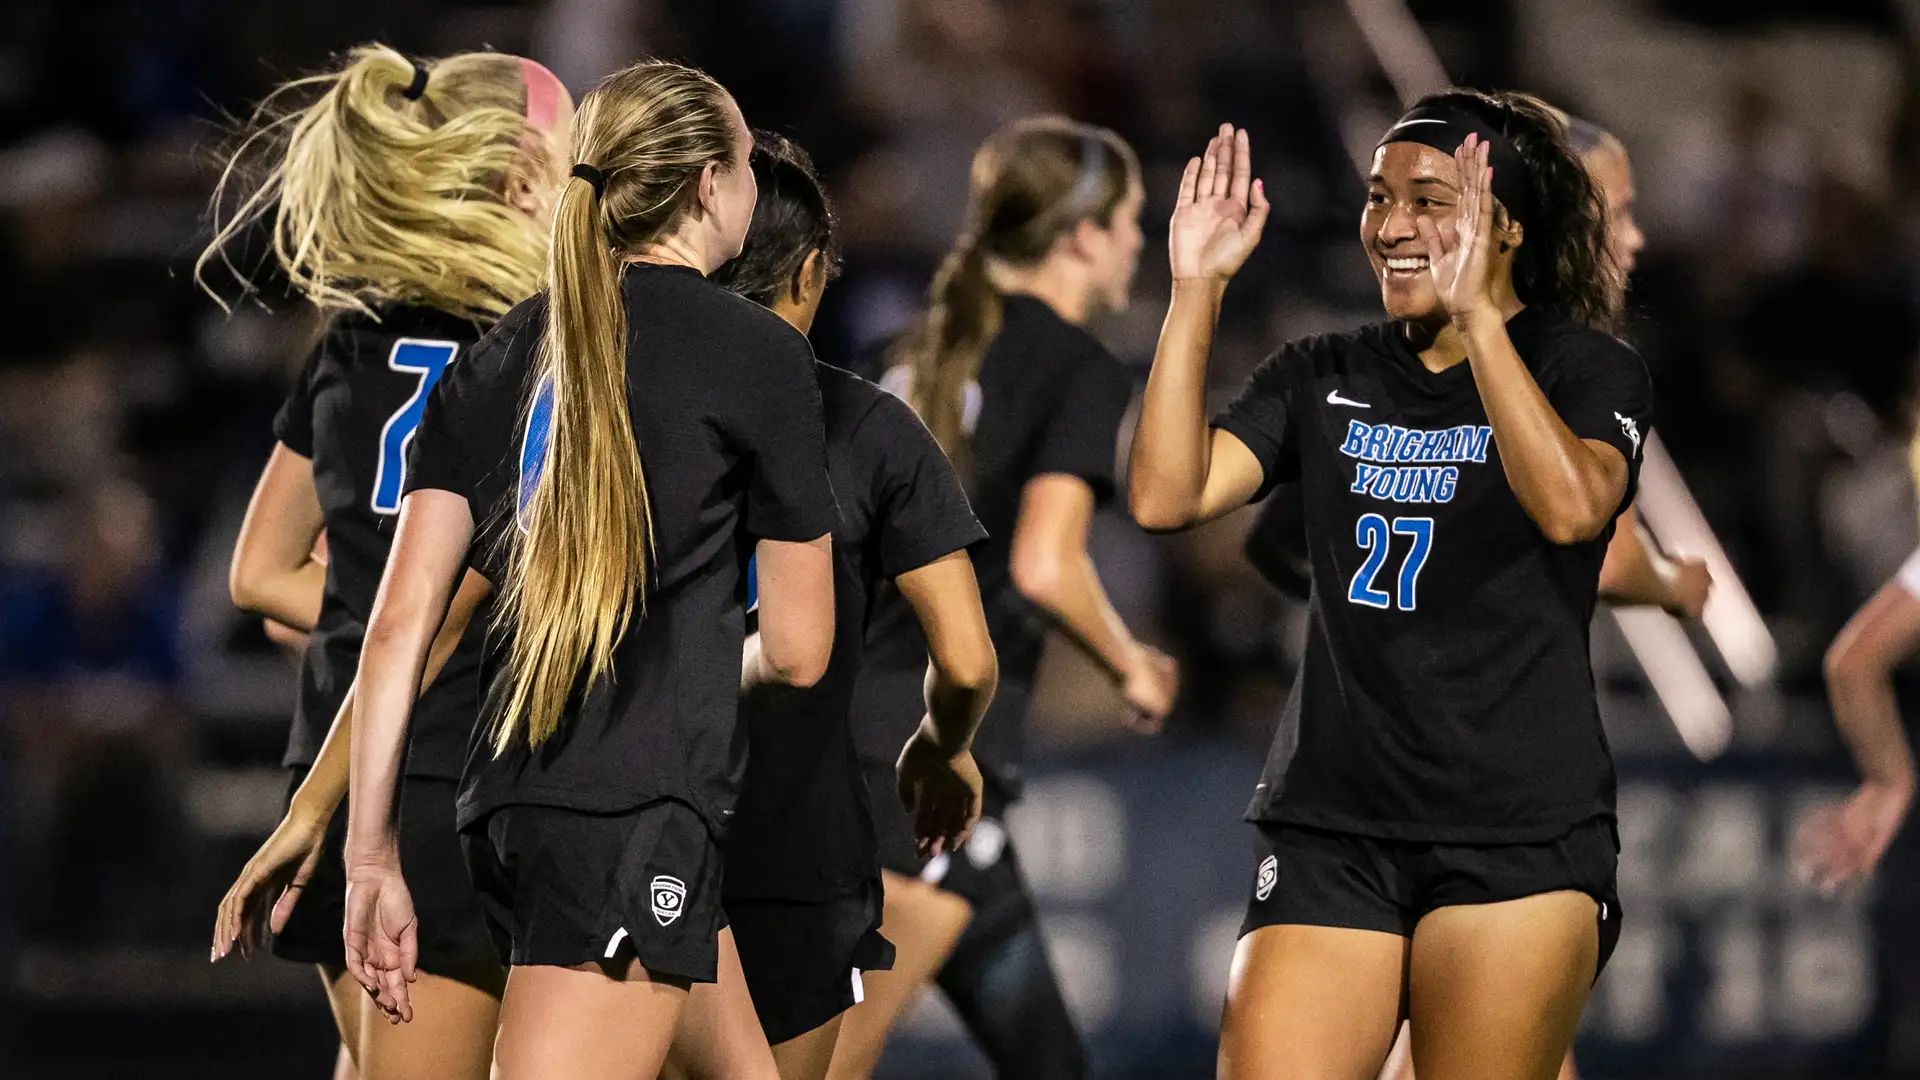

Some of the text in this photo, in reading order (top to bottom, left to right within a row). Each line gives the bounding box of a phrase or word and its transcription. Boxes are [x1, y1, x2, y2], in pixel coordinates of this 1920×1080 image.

[371, 337, 459, 514] 7
[1340, 419, 1492, 463] BRIGHAM
[1351, 463, 1458, 503] YOUNG
[1348, 513, 1434, 611] 27
[661, 893, 675, 906] Y
